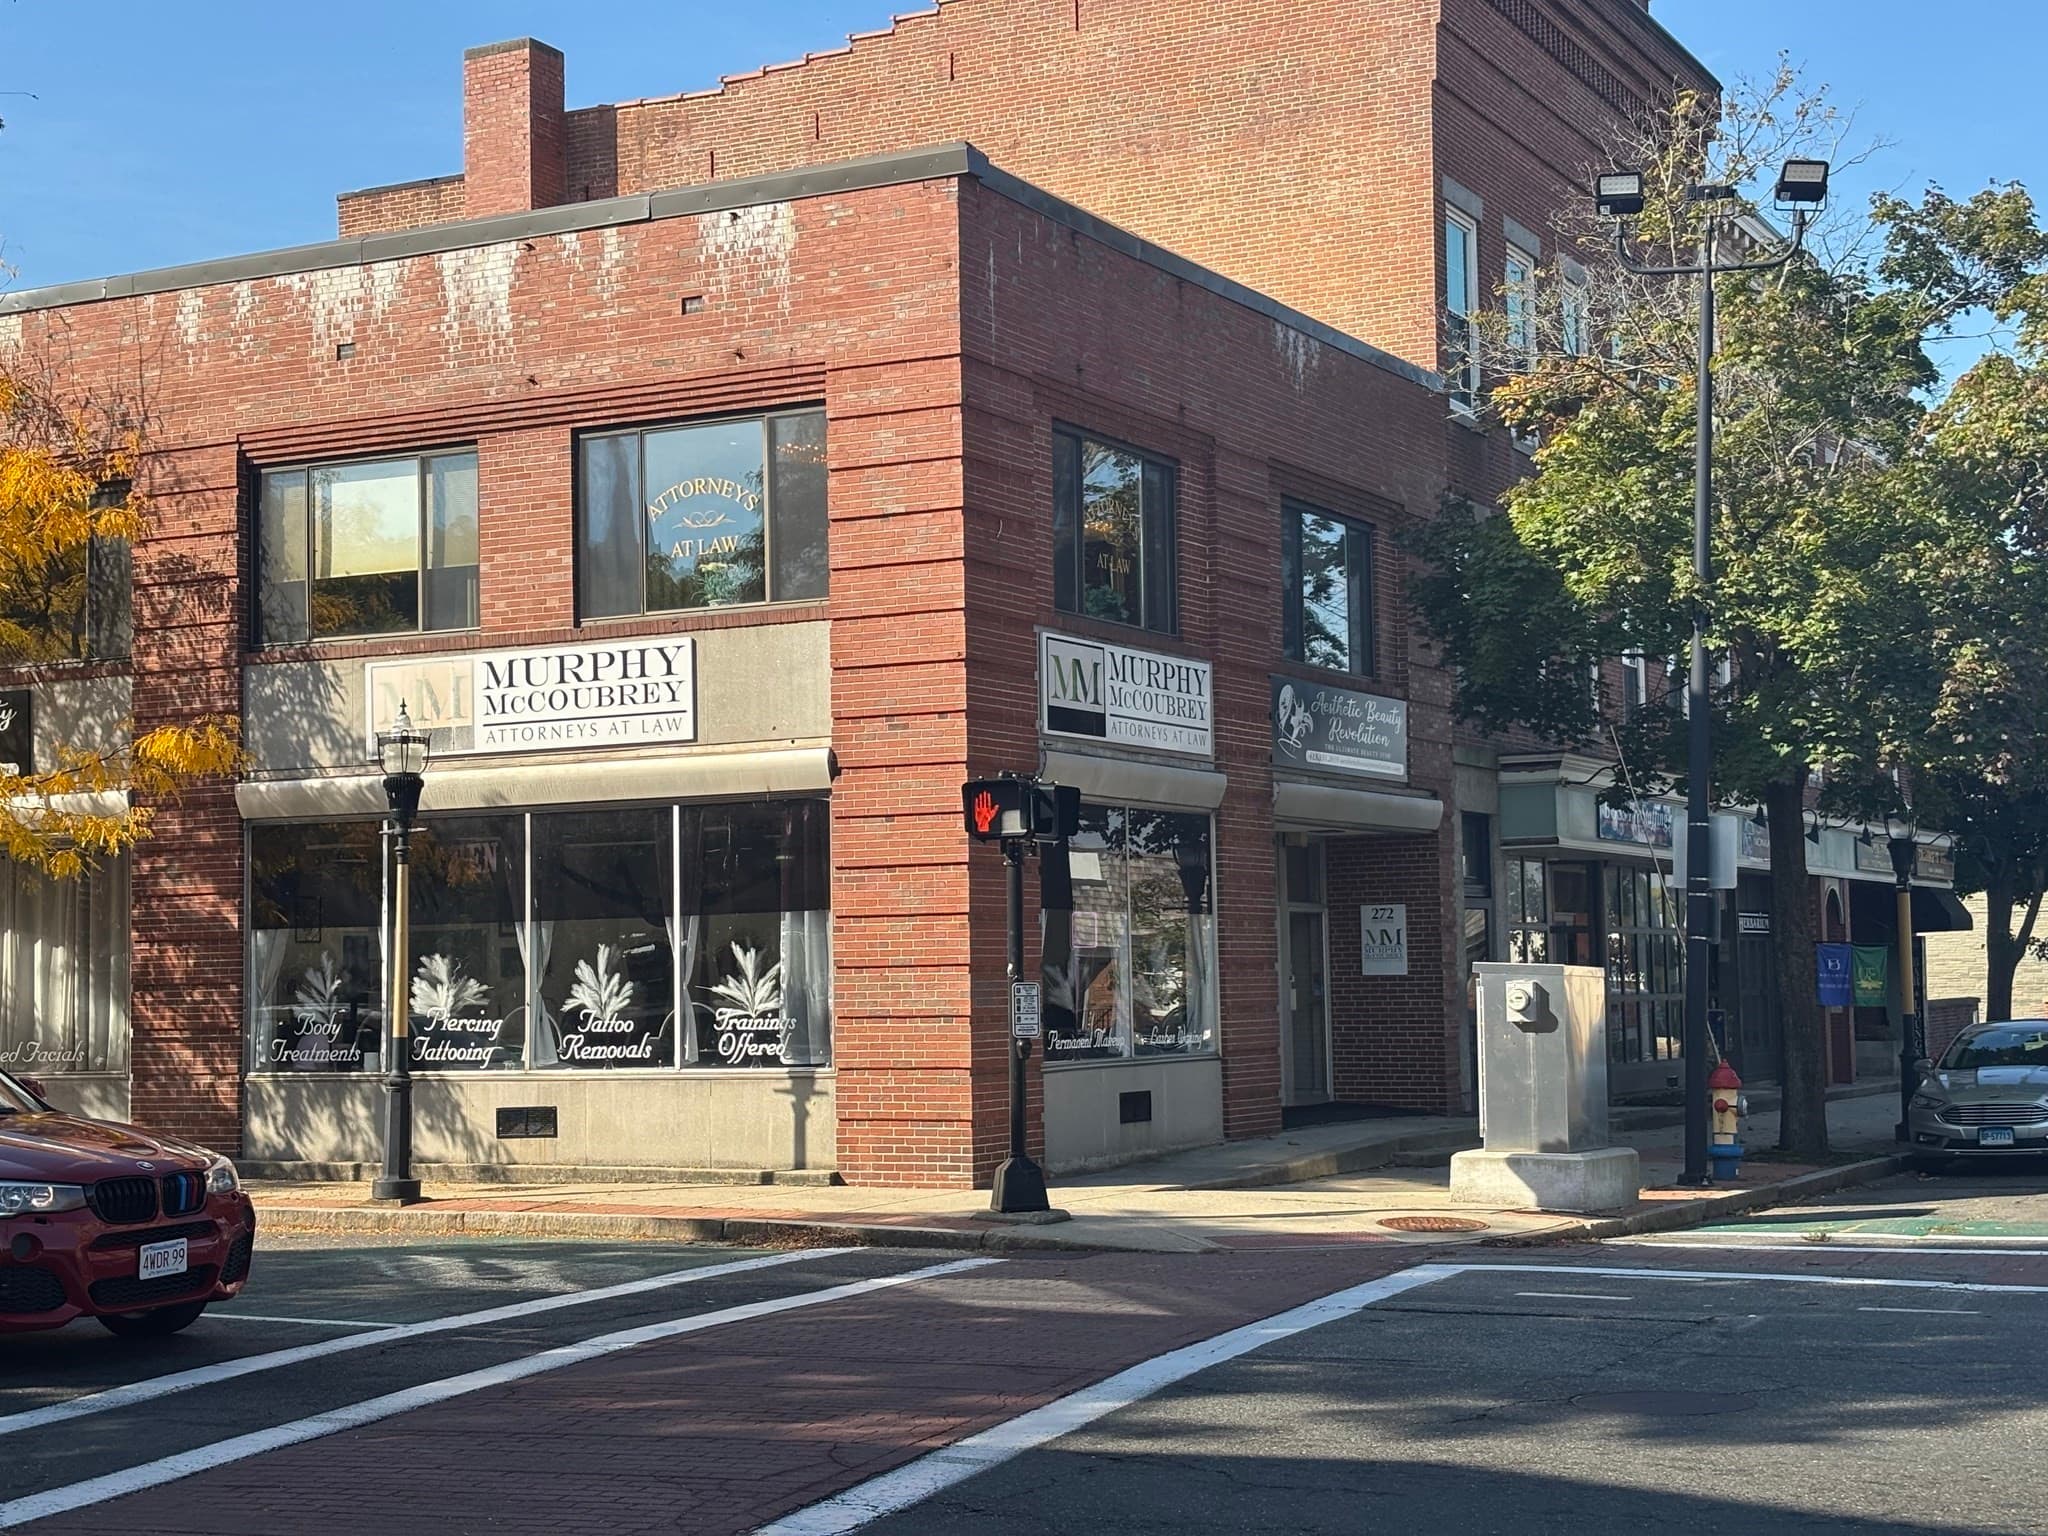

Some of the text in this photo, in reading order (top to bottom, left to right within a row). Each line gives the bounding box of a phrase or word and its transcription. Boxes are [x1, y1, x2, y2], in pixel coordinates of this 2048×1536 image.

[648, 477, 760, 523] ATTORNEYS
[671, 536, 739, 559] AT LAW
[1097, 552, 1109, 570] AT
[482, 645, 686, 690] MURPHY
[1051, 654, 1103, 706] MM
[1109, 652, 1208, 697] MURPHY
[483, 680, 685, 717] McCOUBREY
[1109, 685, 1208, 721] McCOUBREY
[1311, 691, 1402, 734] Aesthetic Beauty
[486, 716, 683, 744] ATTORNEYS AT LAW
[1111, 721, 1207, 747] ATTORNEYS AT LAW
[1328, 718, 1391, 747] Revolution
[1371, 907, 1394, 920] 272
[1364, 928, 1402, 946] MM
[294, 1012, 342, 1044] Body
[424, 1006, 503, 1040] Piercing
[577, 1009, 635, 1033] Tattoo
[714, 1007, 797, 1038] Trainings
[22, 1040, 85, 1063] Facials
[270, 1038, 361, 1062] Treatments
[411, 1036, 504, 1069] Tattooing
[559, 1032, 652, 1060] Removals
[718, 1032, 792, 1064] Offered
[1048, 1029, 1092, 1050] Permanent
[143, 1247, 185, 1271] 4WDR 99
